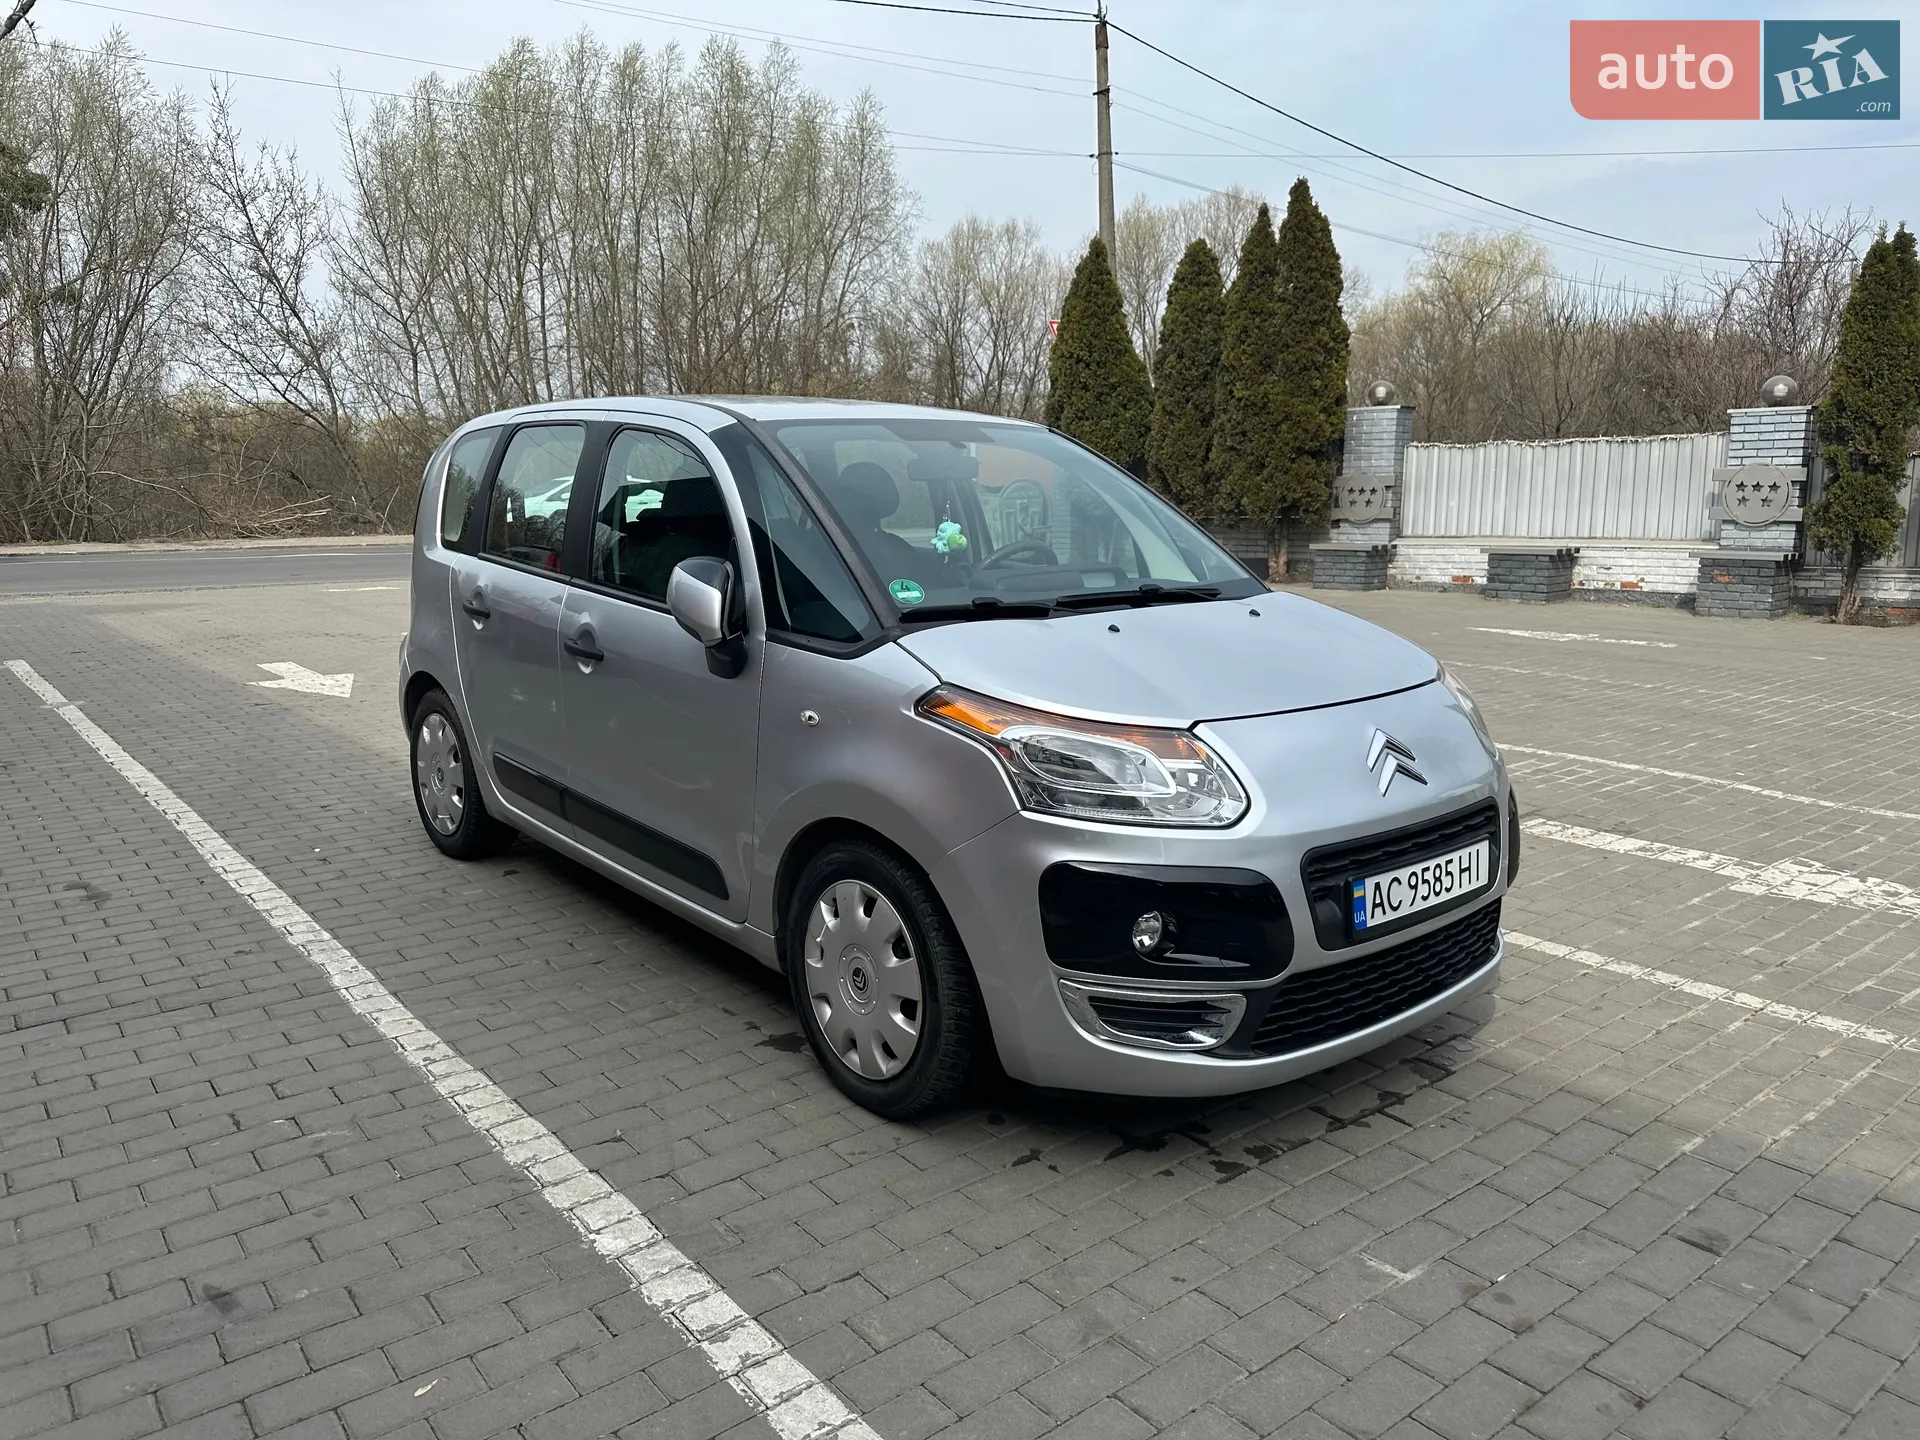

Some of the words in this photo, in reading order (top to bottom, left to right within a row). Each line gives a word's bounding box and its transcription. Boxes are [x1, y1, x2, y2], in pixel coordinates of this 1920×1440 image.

[900, 581, 910, 591] 4
[1370, 876, 1402, 920] AC
[1407, 857, 1454, 907] 9585
[1458, 848, 1480, 888] HI
[1354, 912, 1366, 923] UA
